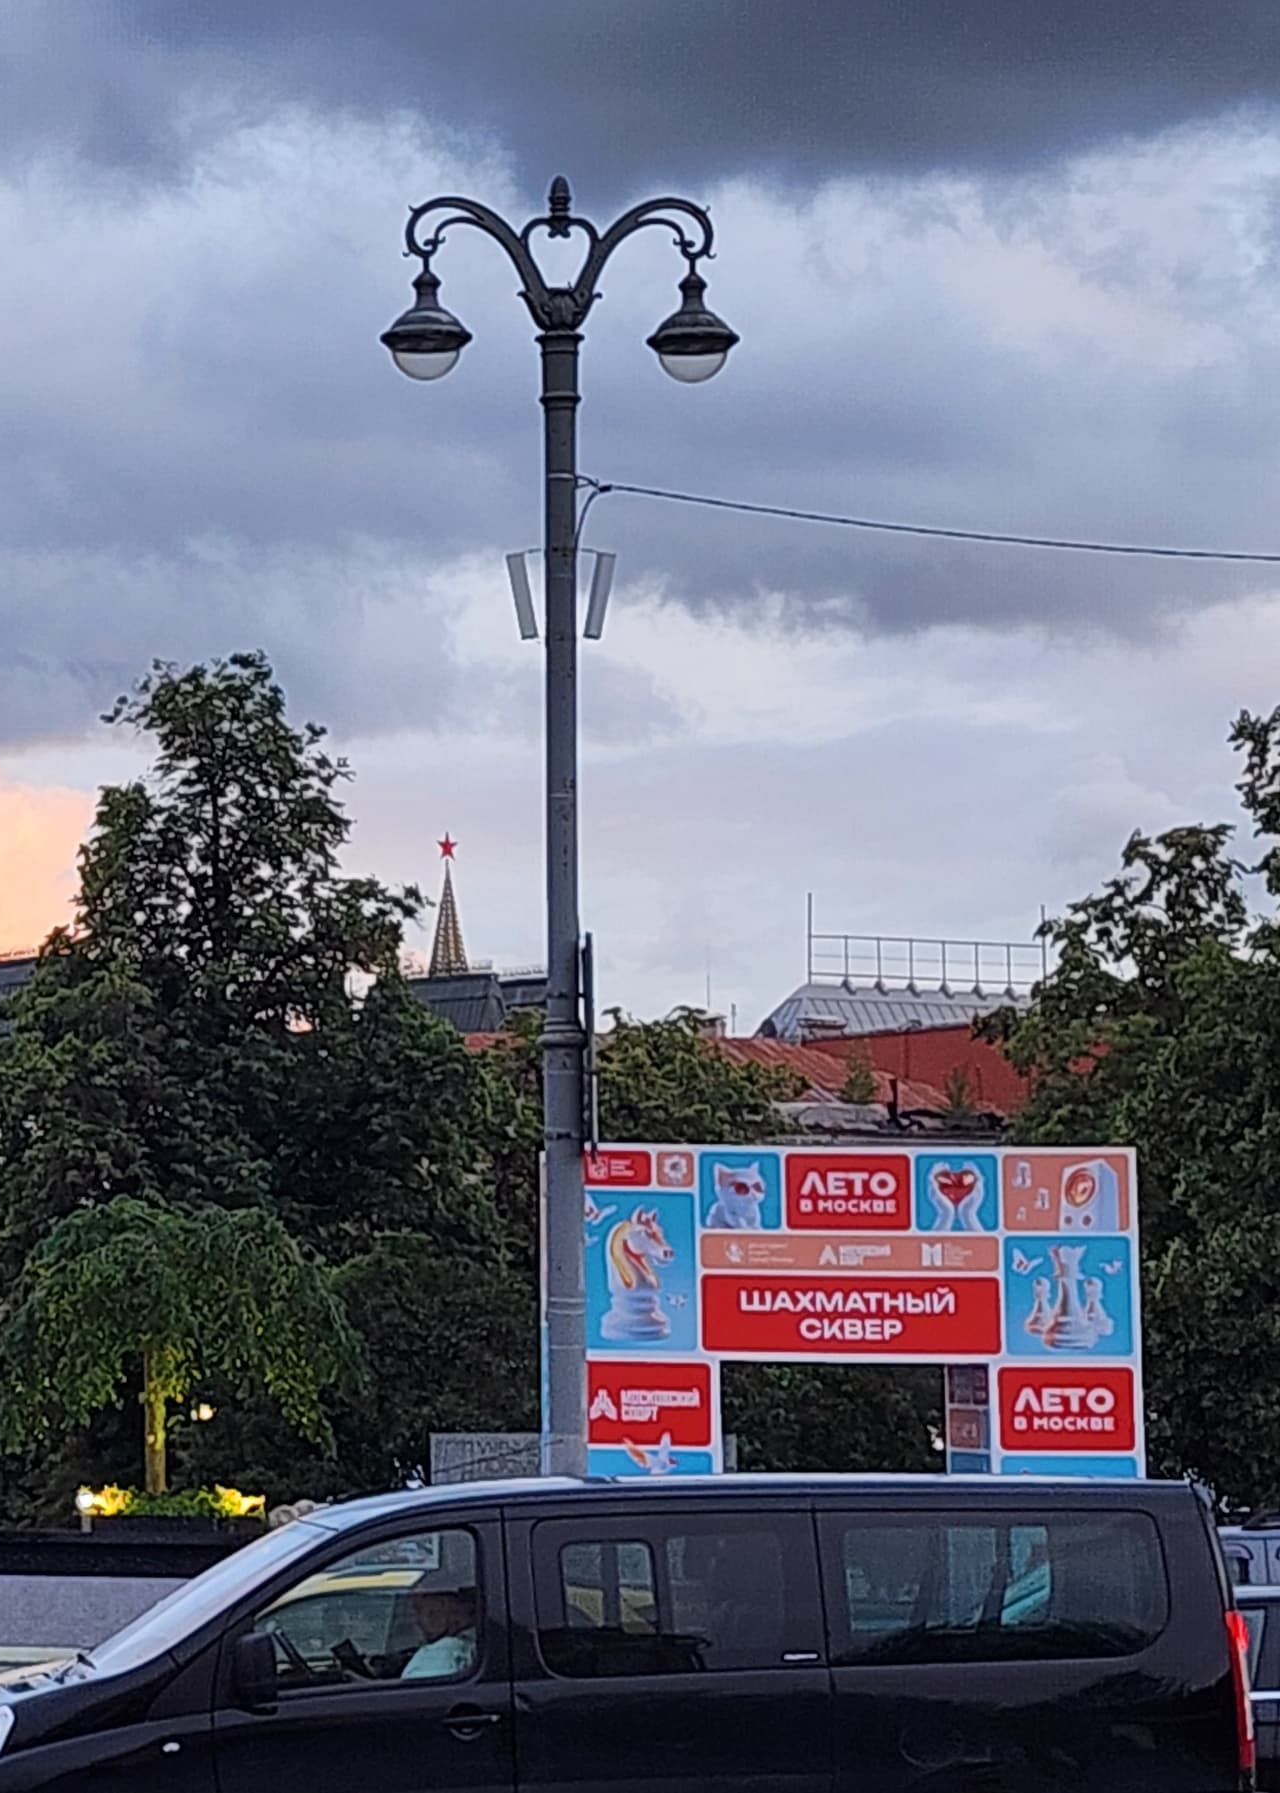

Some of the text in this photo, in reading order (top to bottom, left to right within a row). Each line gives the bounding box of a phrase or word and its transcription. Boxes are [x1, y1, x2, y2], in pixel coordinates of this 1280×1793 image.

[800, 1171, 897, 1196] ЛЕТО
[800, 1199, 897, 1213] В МОСКВЕ
[739, 1286, 955, 1314] ШАХМАТНЫЙ
[799, 1317, 903, 1341] СКВЕР
[1014, 1387, 1115, 1413] ЛЕТО
[1013, 1416, 1115, 1431] В МОСКВЕ
